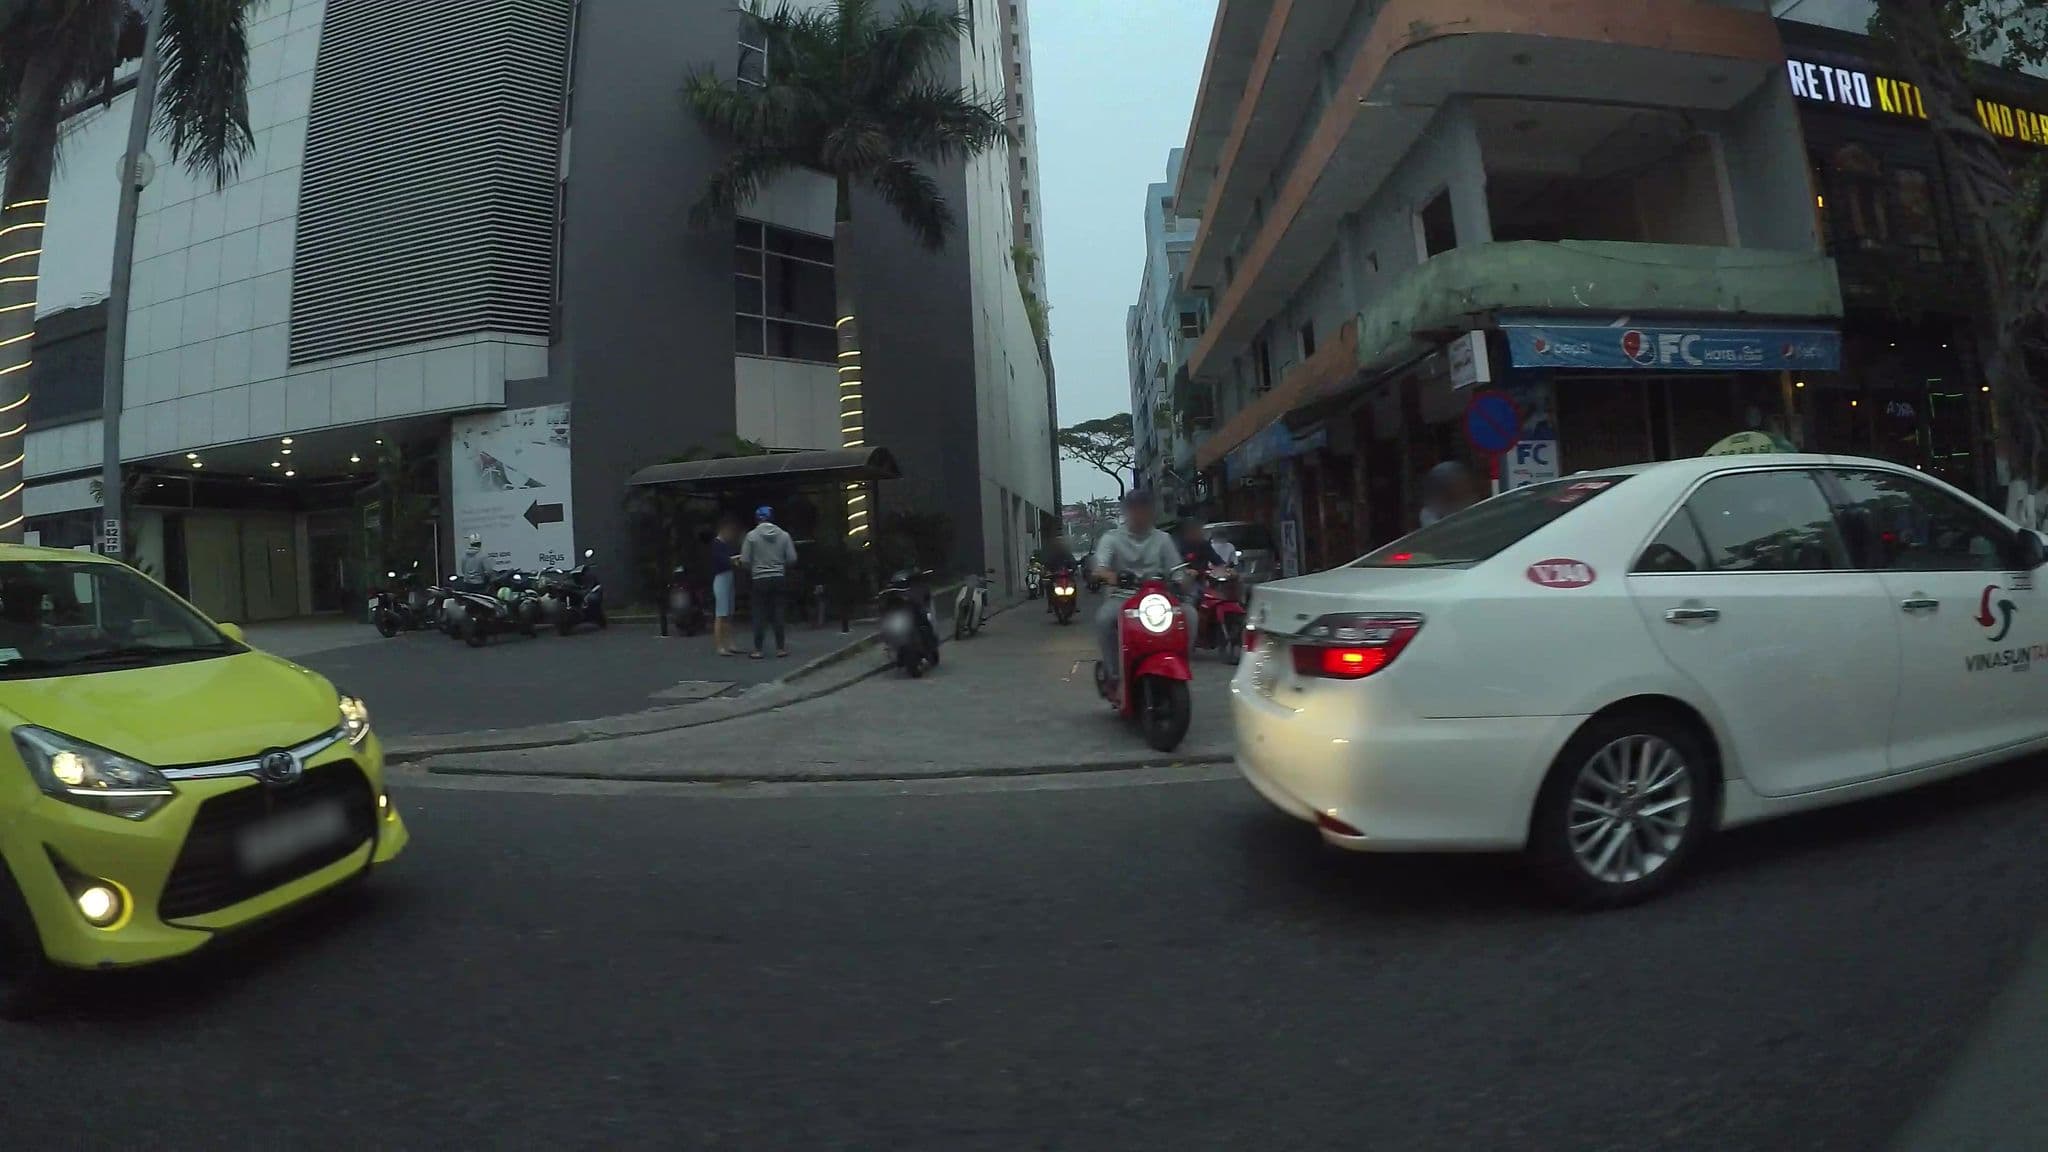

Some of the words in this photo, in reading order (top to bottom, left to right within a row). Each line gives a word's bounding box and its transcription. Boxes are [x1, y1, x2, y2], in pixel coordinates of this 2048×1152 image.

[1787, 60, 1872, 108] RETRO
[1657, 333, 1704, 366] FC
[1517, 443, 1549, 466] FC
[539, 553, 565, 566] Regus
